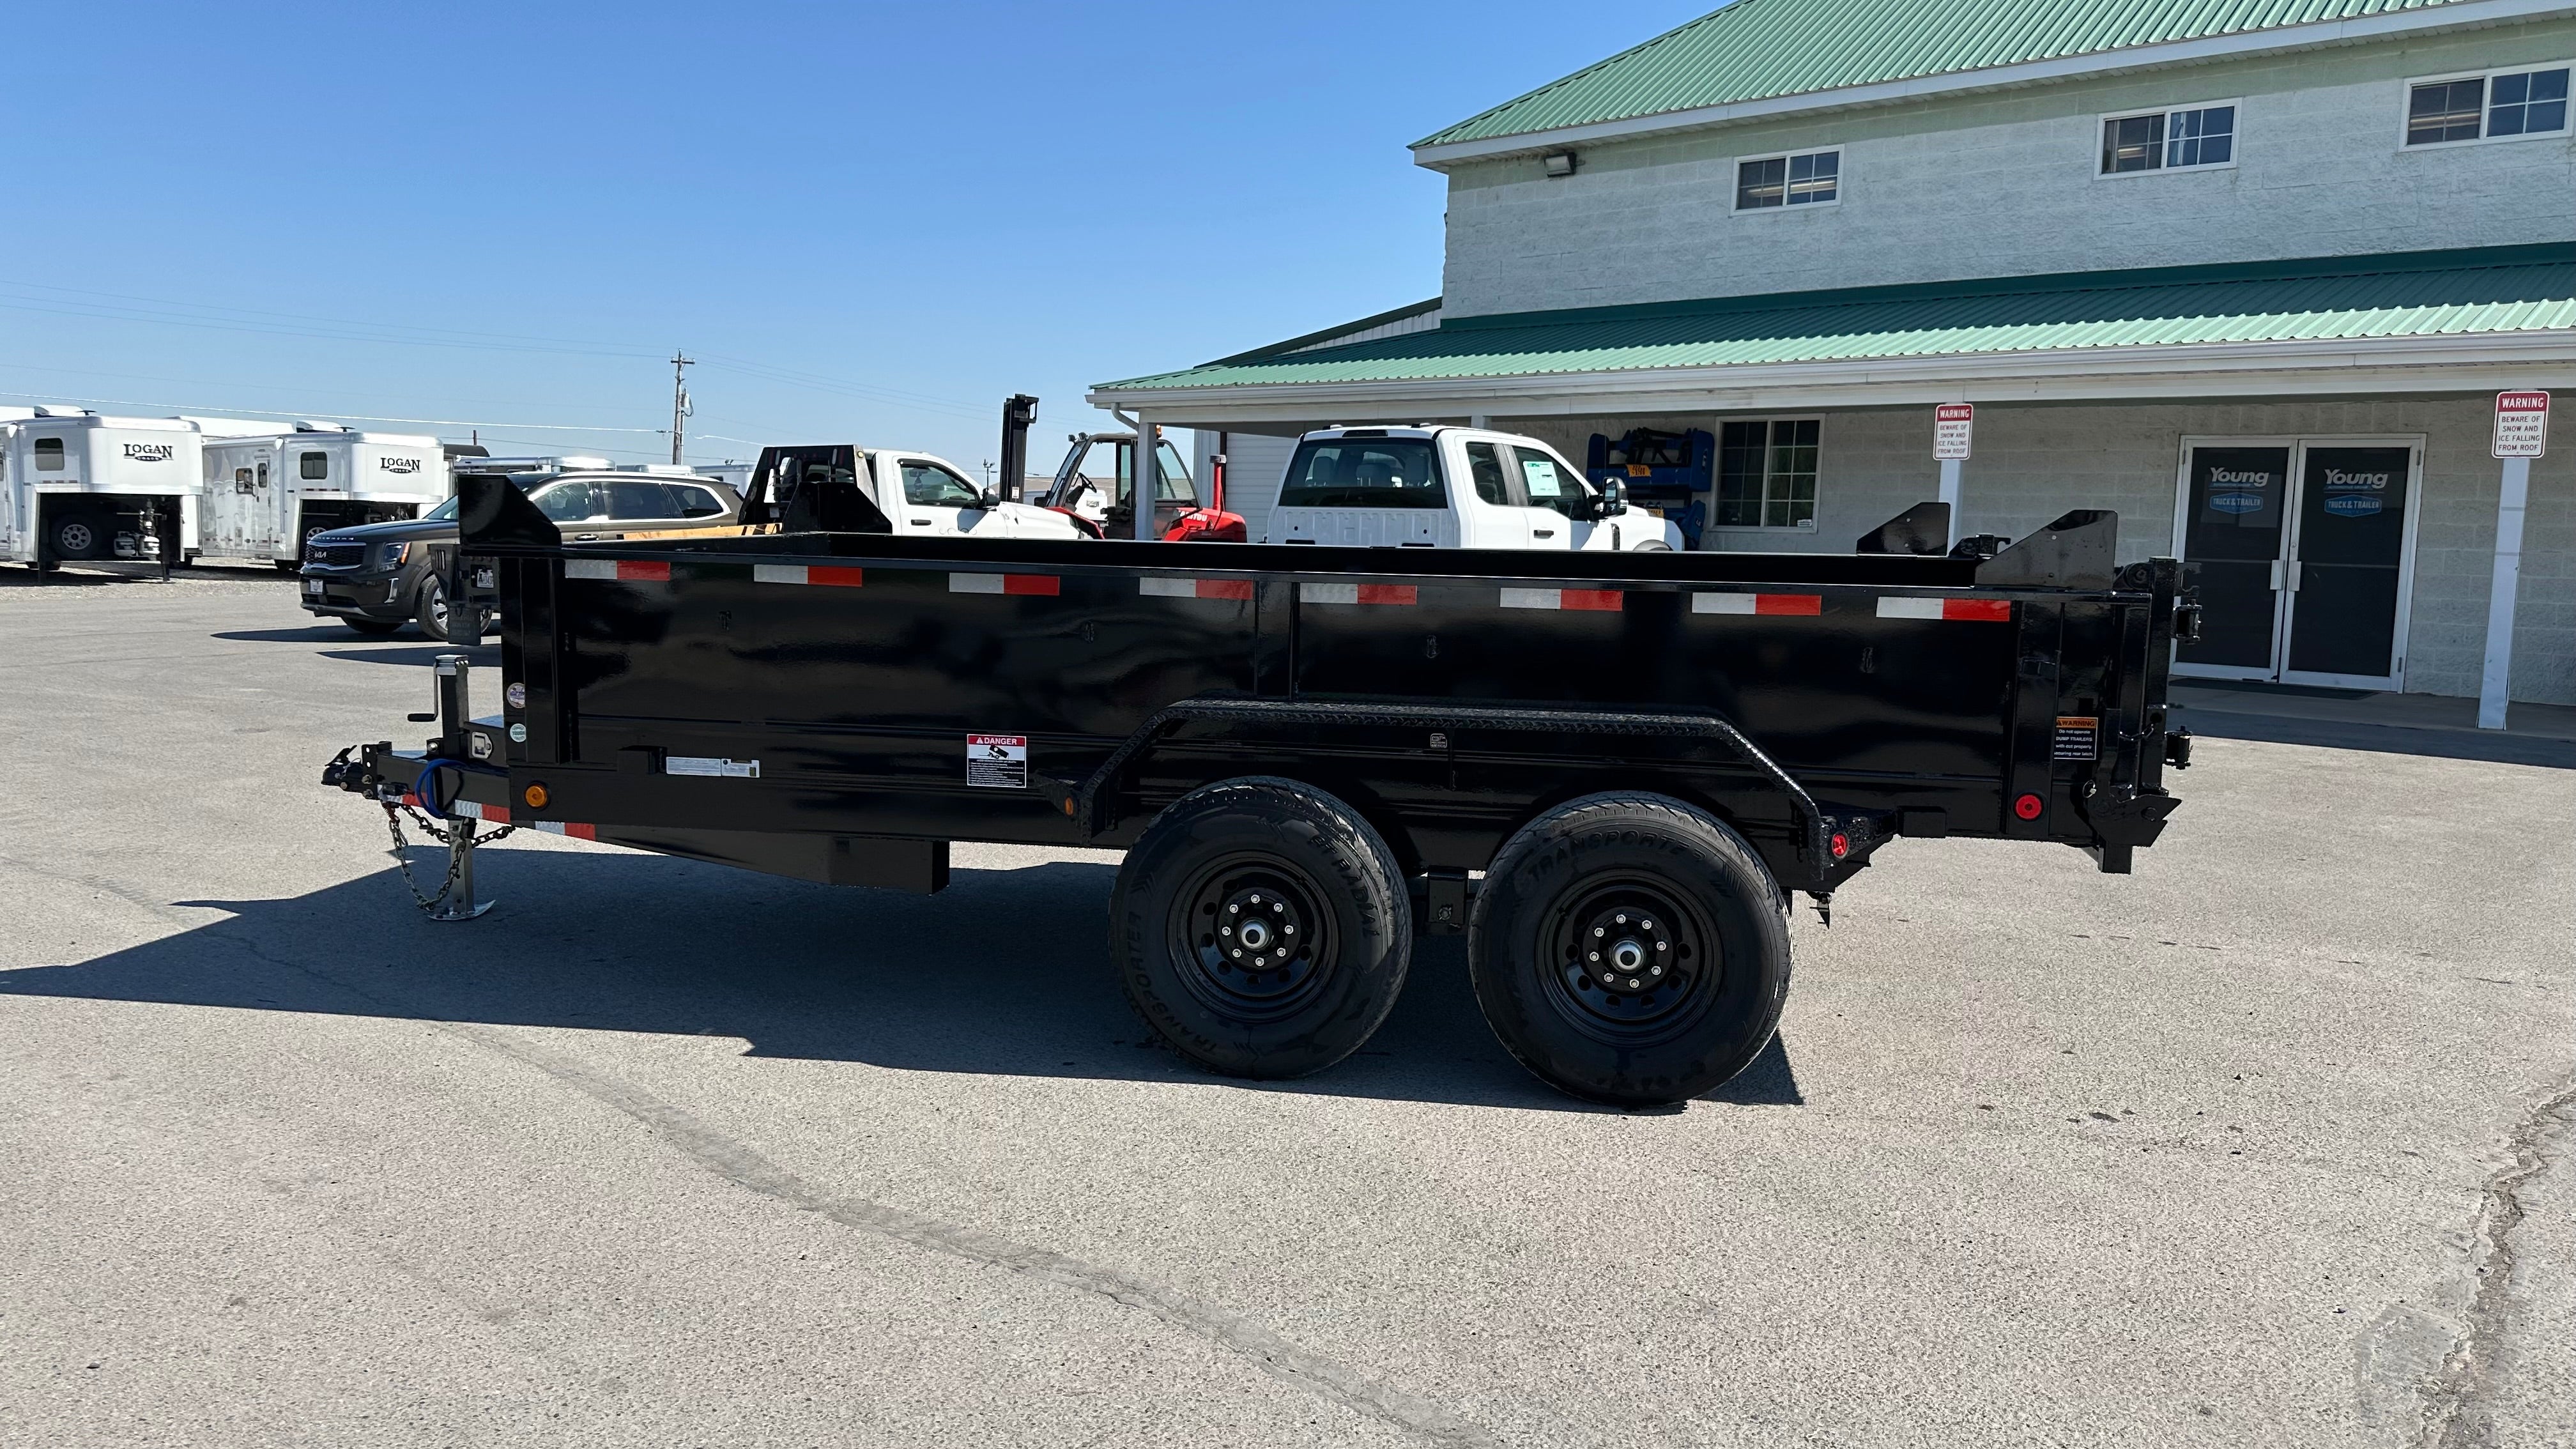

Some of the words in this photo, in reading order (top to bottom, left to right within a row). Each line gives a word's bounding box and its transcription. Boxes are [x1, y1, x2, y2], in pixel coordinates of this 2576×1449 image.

[2502, 397, 2544, 408] WARNING
[1940, 409, 1970, 418] WARNING
[123, 444, 173, 459] LOGAN
[380, 457, 420, 471] LOGAN
[2211, 467, 2269, 487] Young
[2324, 469, 2388, 489] Young
[2354, 501, 2379, 509] TRAILER
[1528, 830, 1706, 881] TRANSPORTER
[1331, 858, 1380, 938] RADIAL
[1127, 911, 1218, 1053] TRANSPORTER
